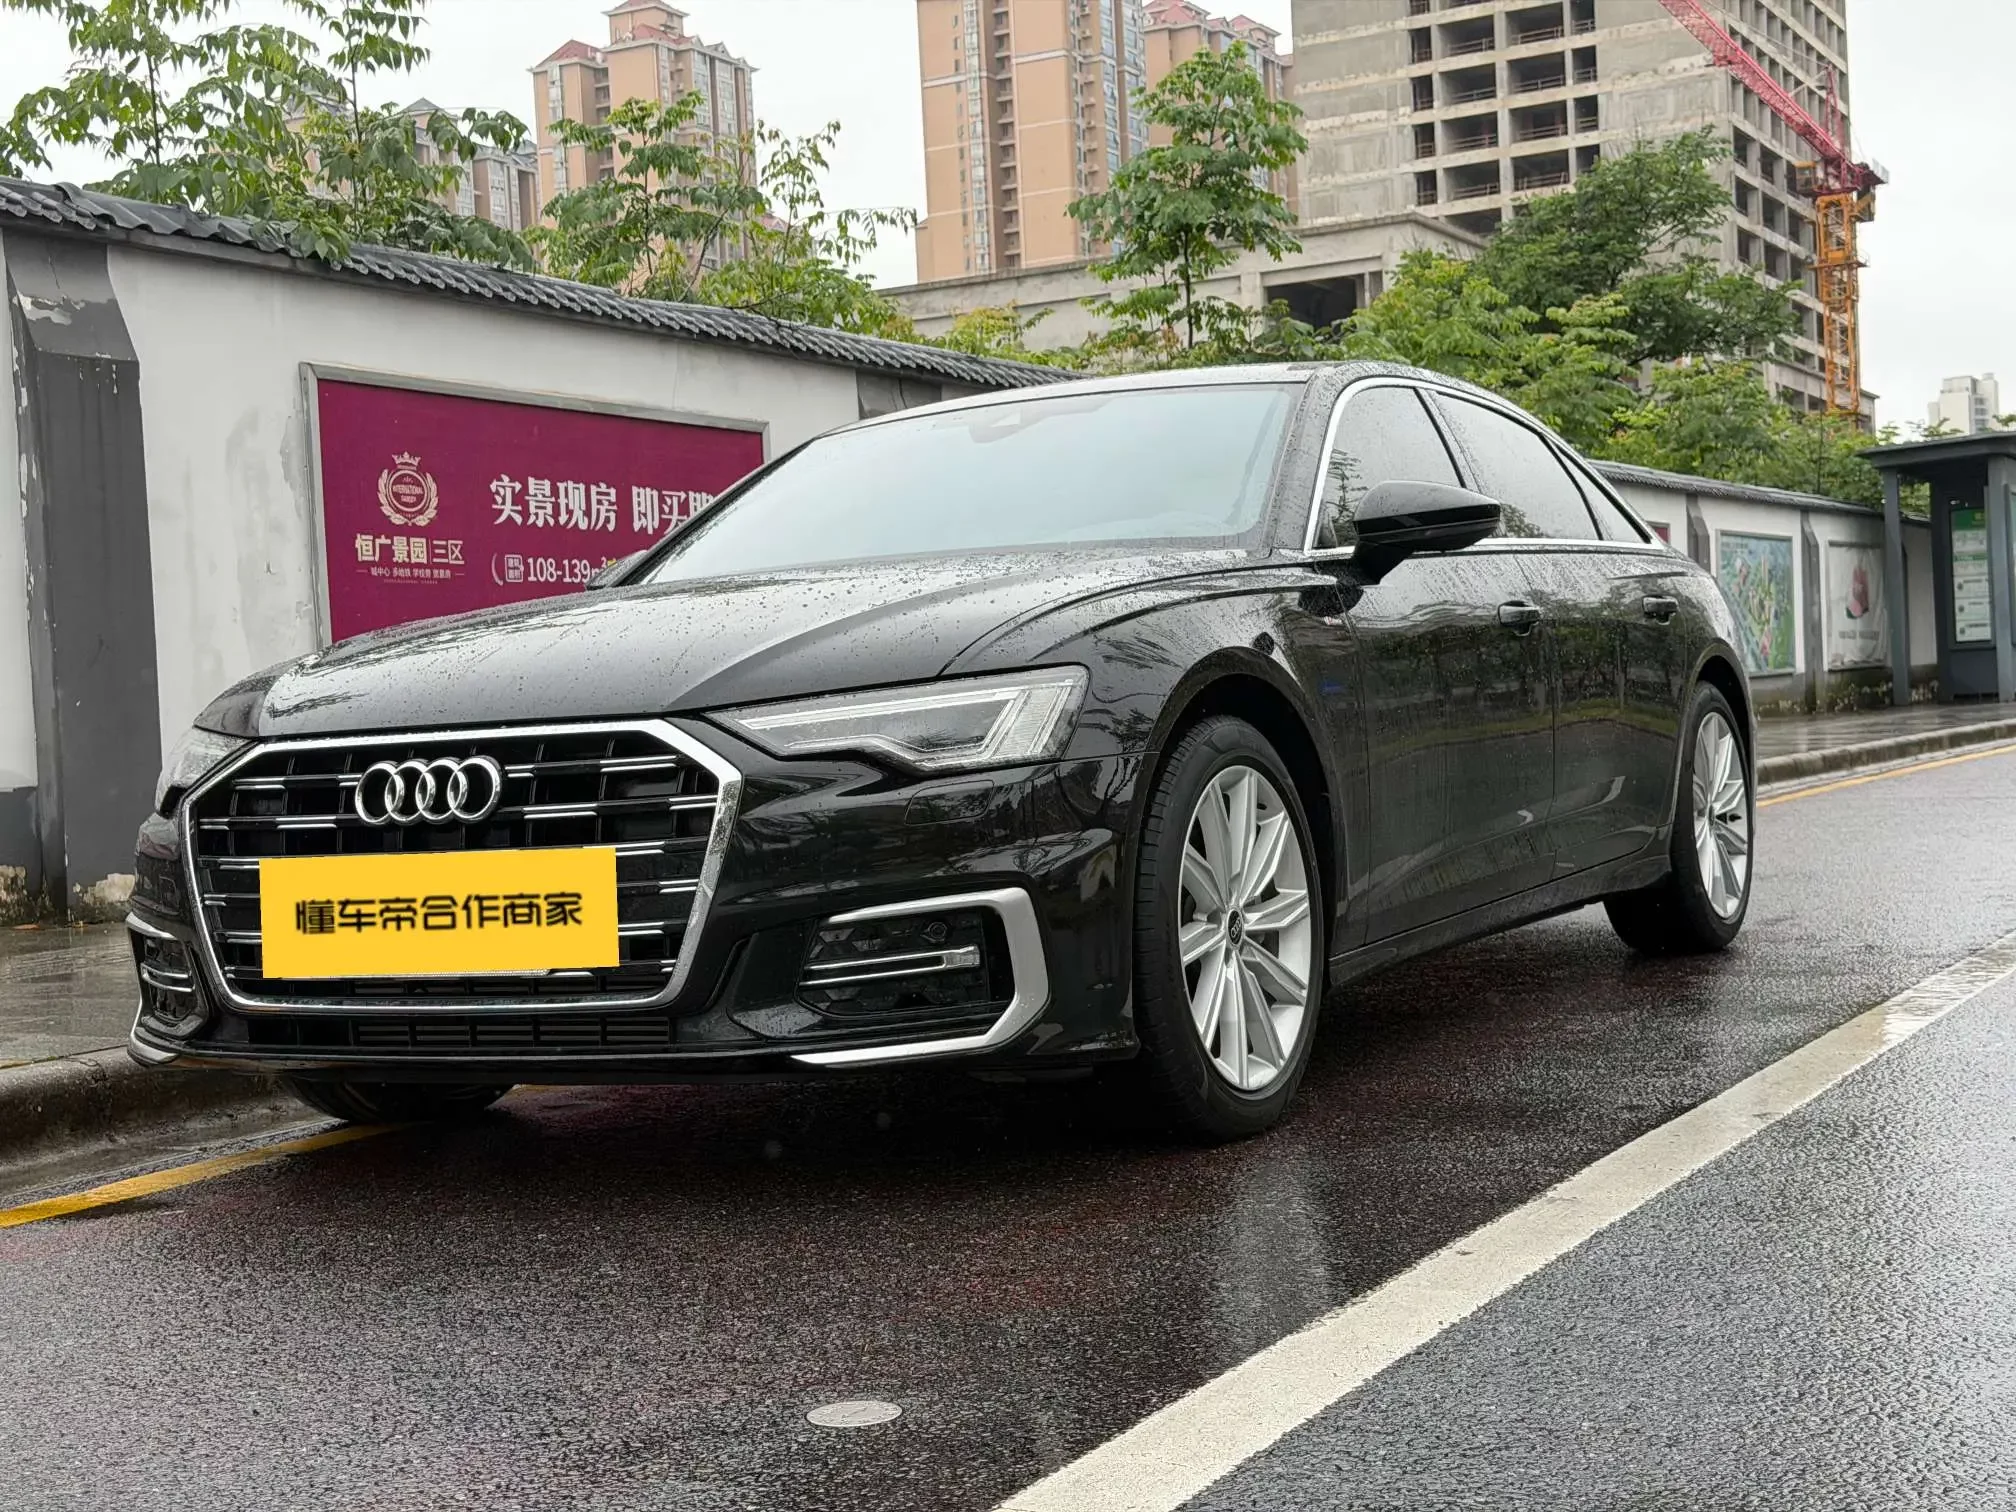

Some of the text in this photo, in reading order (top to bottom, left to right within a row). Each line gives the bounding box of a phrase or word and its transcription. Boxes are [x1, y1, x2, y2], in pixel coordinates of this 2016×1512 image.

[490, 474, 617, 532] 实景现房
[355, 533, 465, 565] 恒广景园 三区
